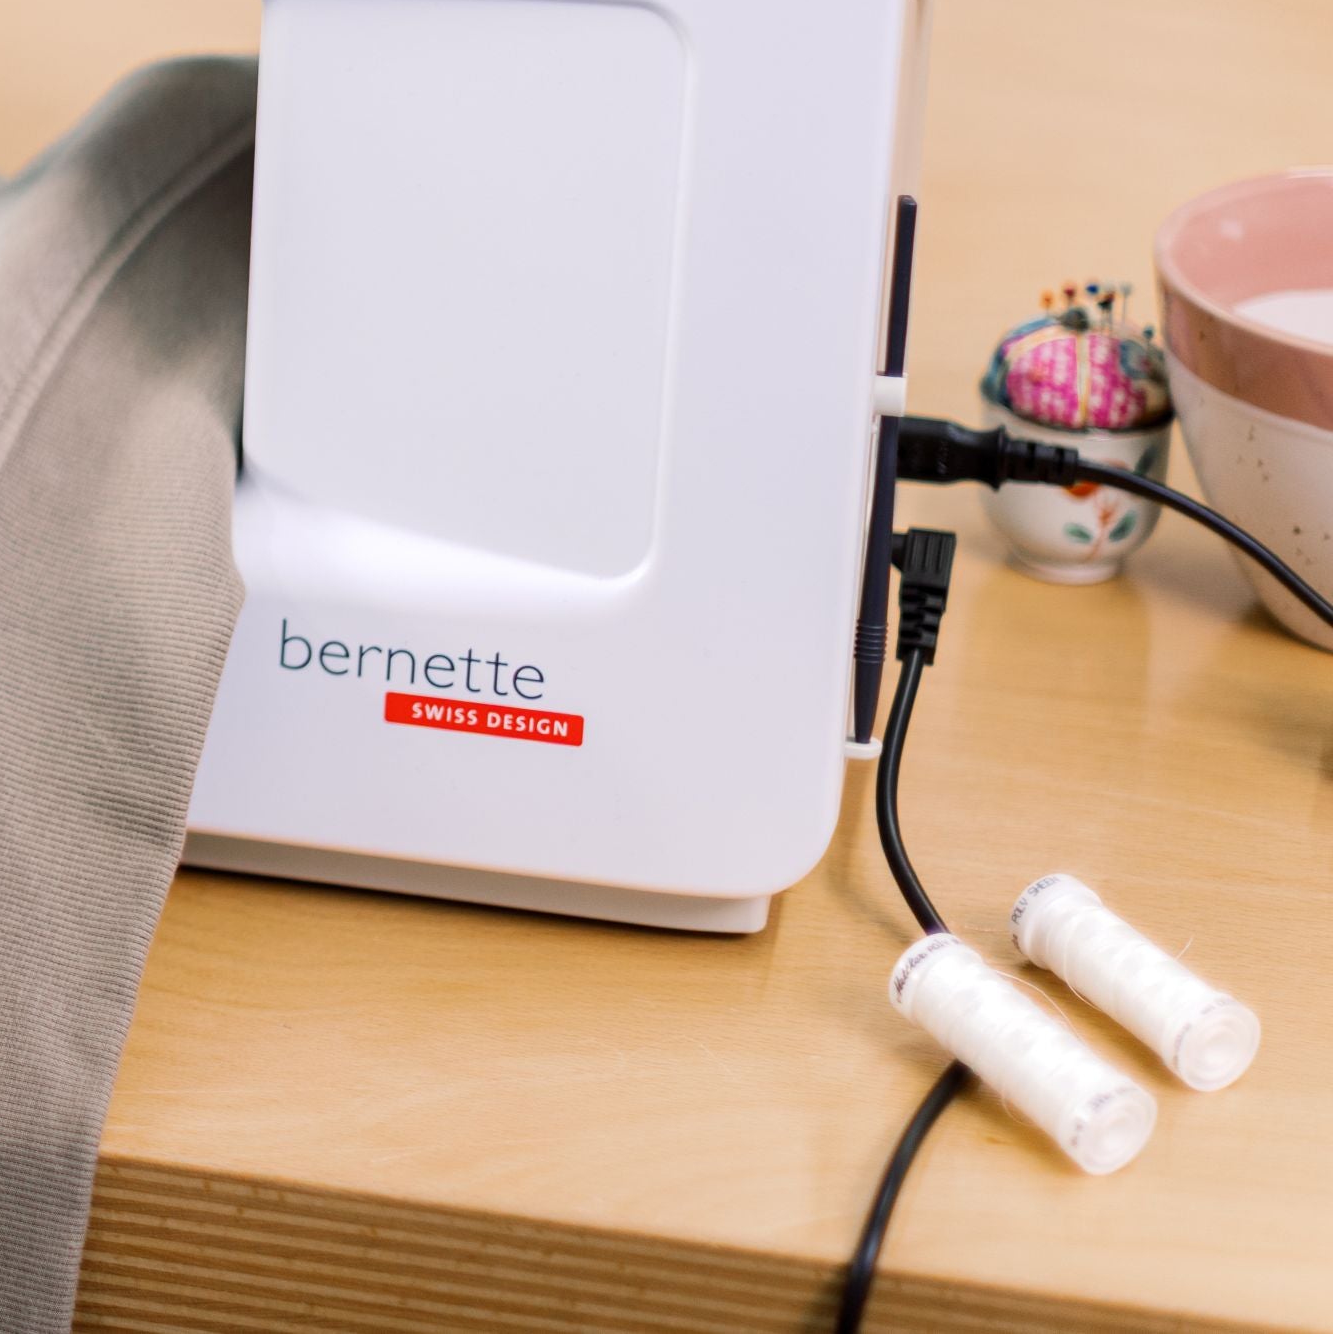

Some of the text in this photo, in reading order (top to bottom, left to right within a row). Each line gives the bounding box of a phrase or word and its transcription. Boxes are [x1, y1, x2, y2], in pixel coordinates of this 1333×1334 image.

[278, 618, 546, 701] bernette
[410, 701, 570, 738] SWISS DESIGN
[1010, 897, 1029, 925] POLY
[1026, 875, 1061, 898] SHEEN
